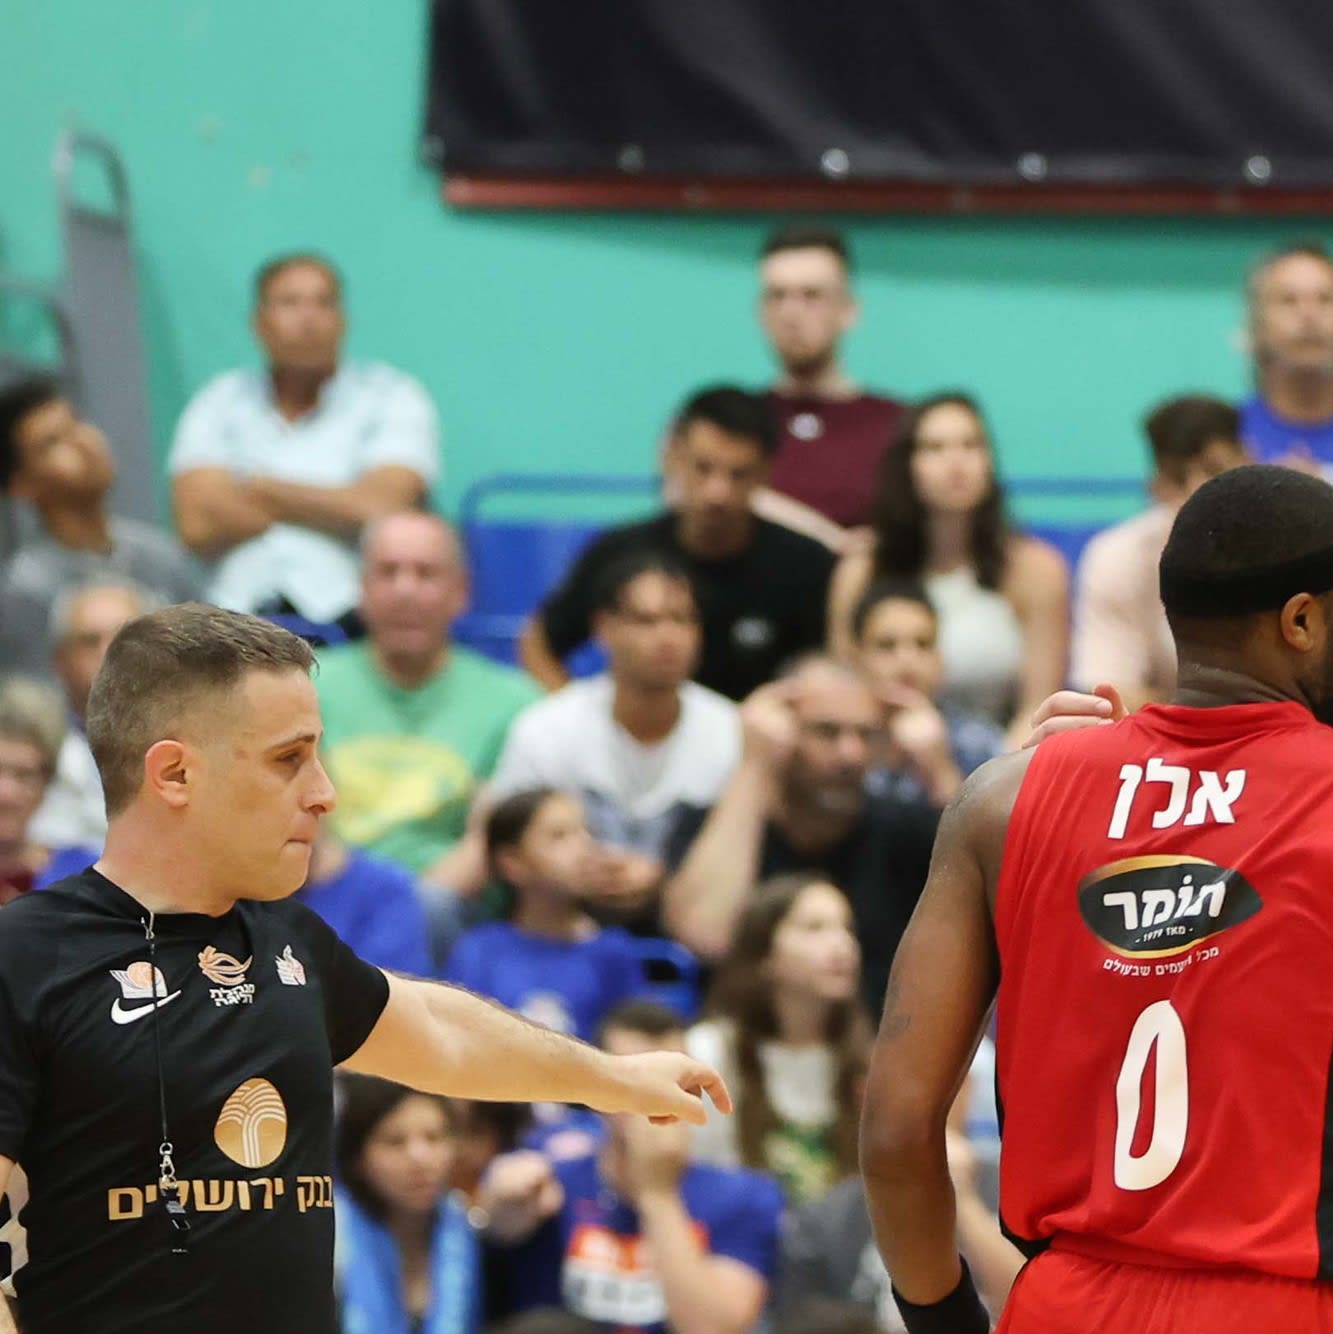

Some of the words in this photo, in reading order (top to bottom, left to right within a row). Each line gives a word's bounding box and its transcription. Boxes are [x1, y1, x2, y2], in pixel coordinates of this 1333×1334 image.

[1107, 757, 1247, 840] אלן
[1113, 999, 1189, 1192] 0
[297, 1175, 333, 1213] בנק
